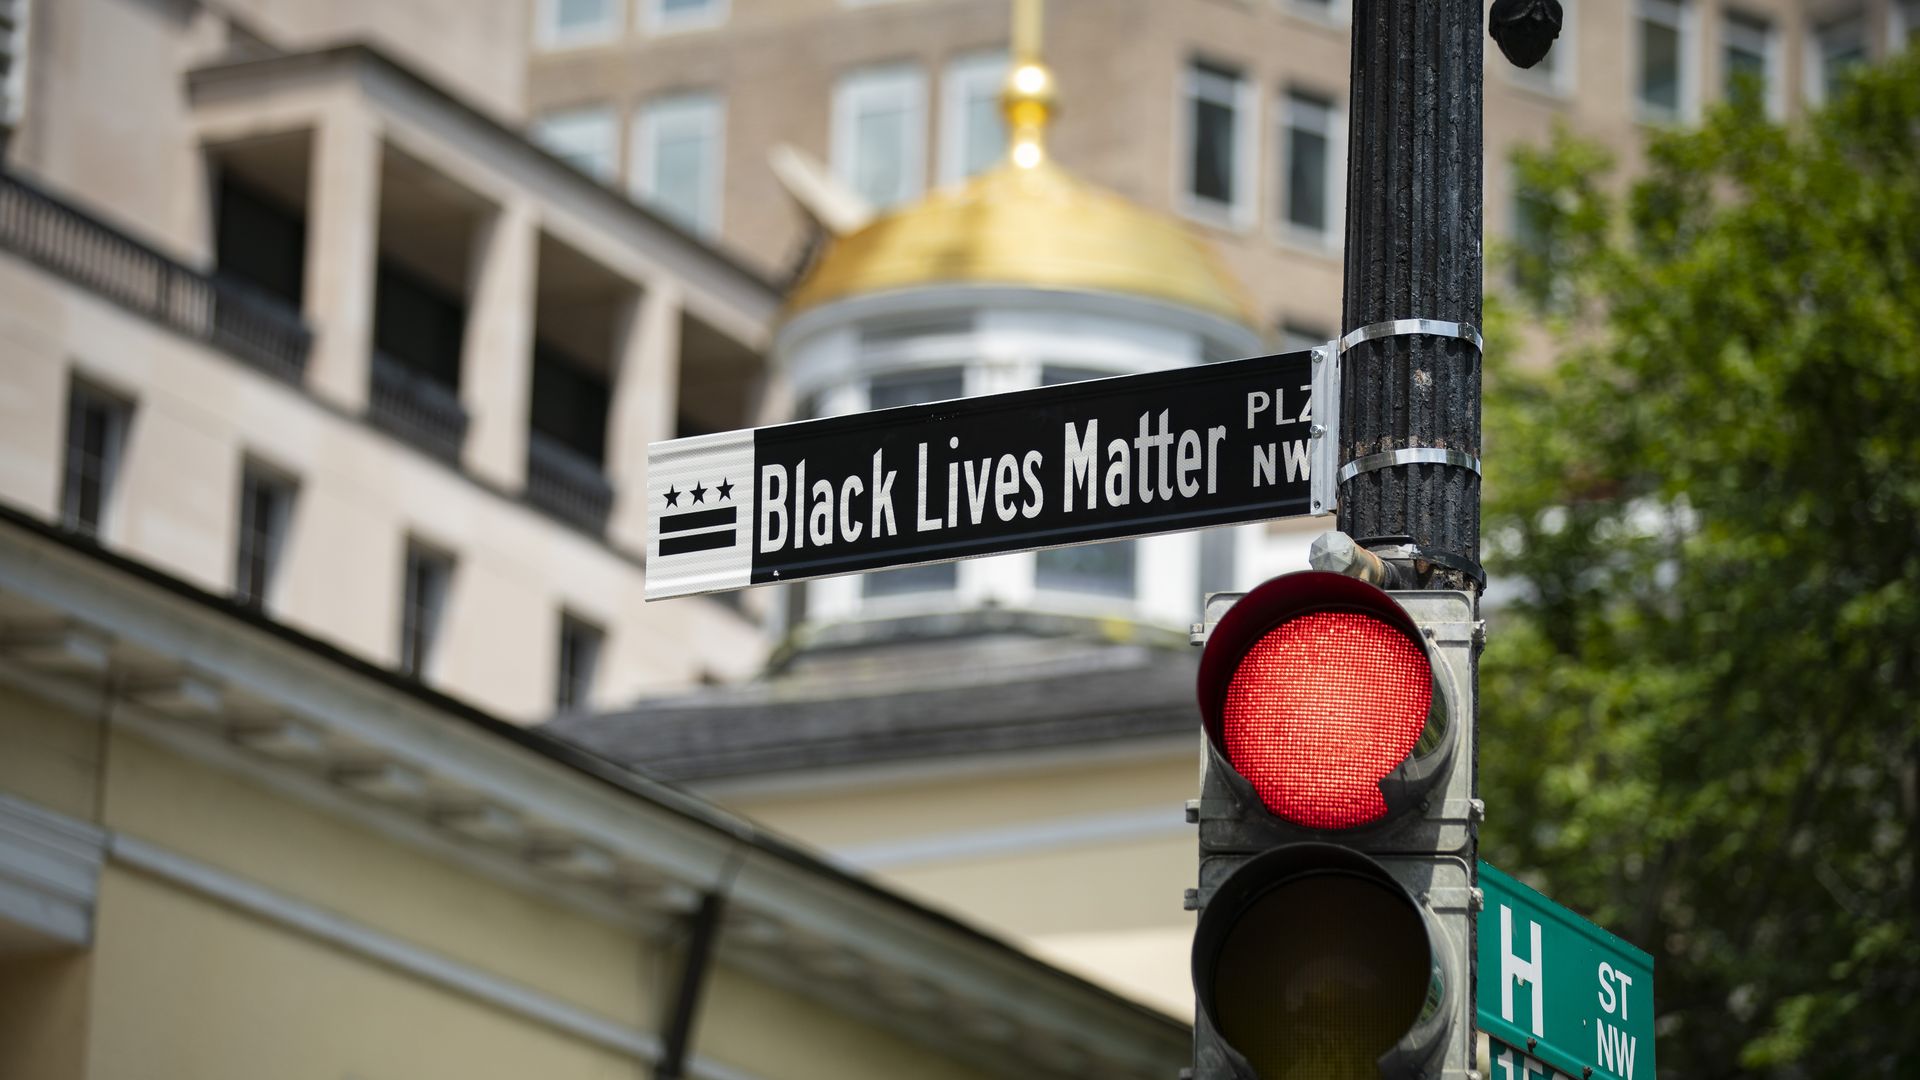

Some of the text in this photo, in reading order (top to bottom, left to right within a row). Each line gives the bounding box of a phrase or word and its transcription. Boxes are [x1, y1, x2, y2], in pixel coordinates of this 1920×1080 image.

[1247, 384, 1313, 429] PLZ
[759, 407, 1227, 554] Black Lives Matter
[1252, 438, 1312, 488] NW
[1500, 903, 1544, 1038] H
[1598, 961, 1633, 1021] ST
[1596, 1017, 1637, 1080] NW
